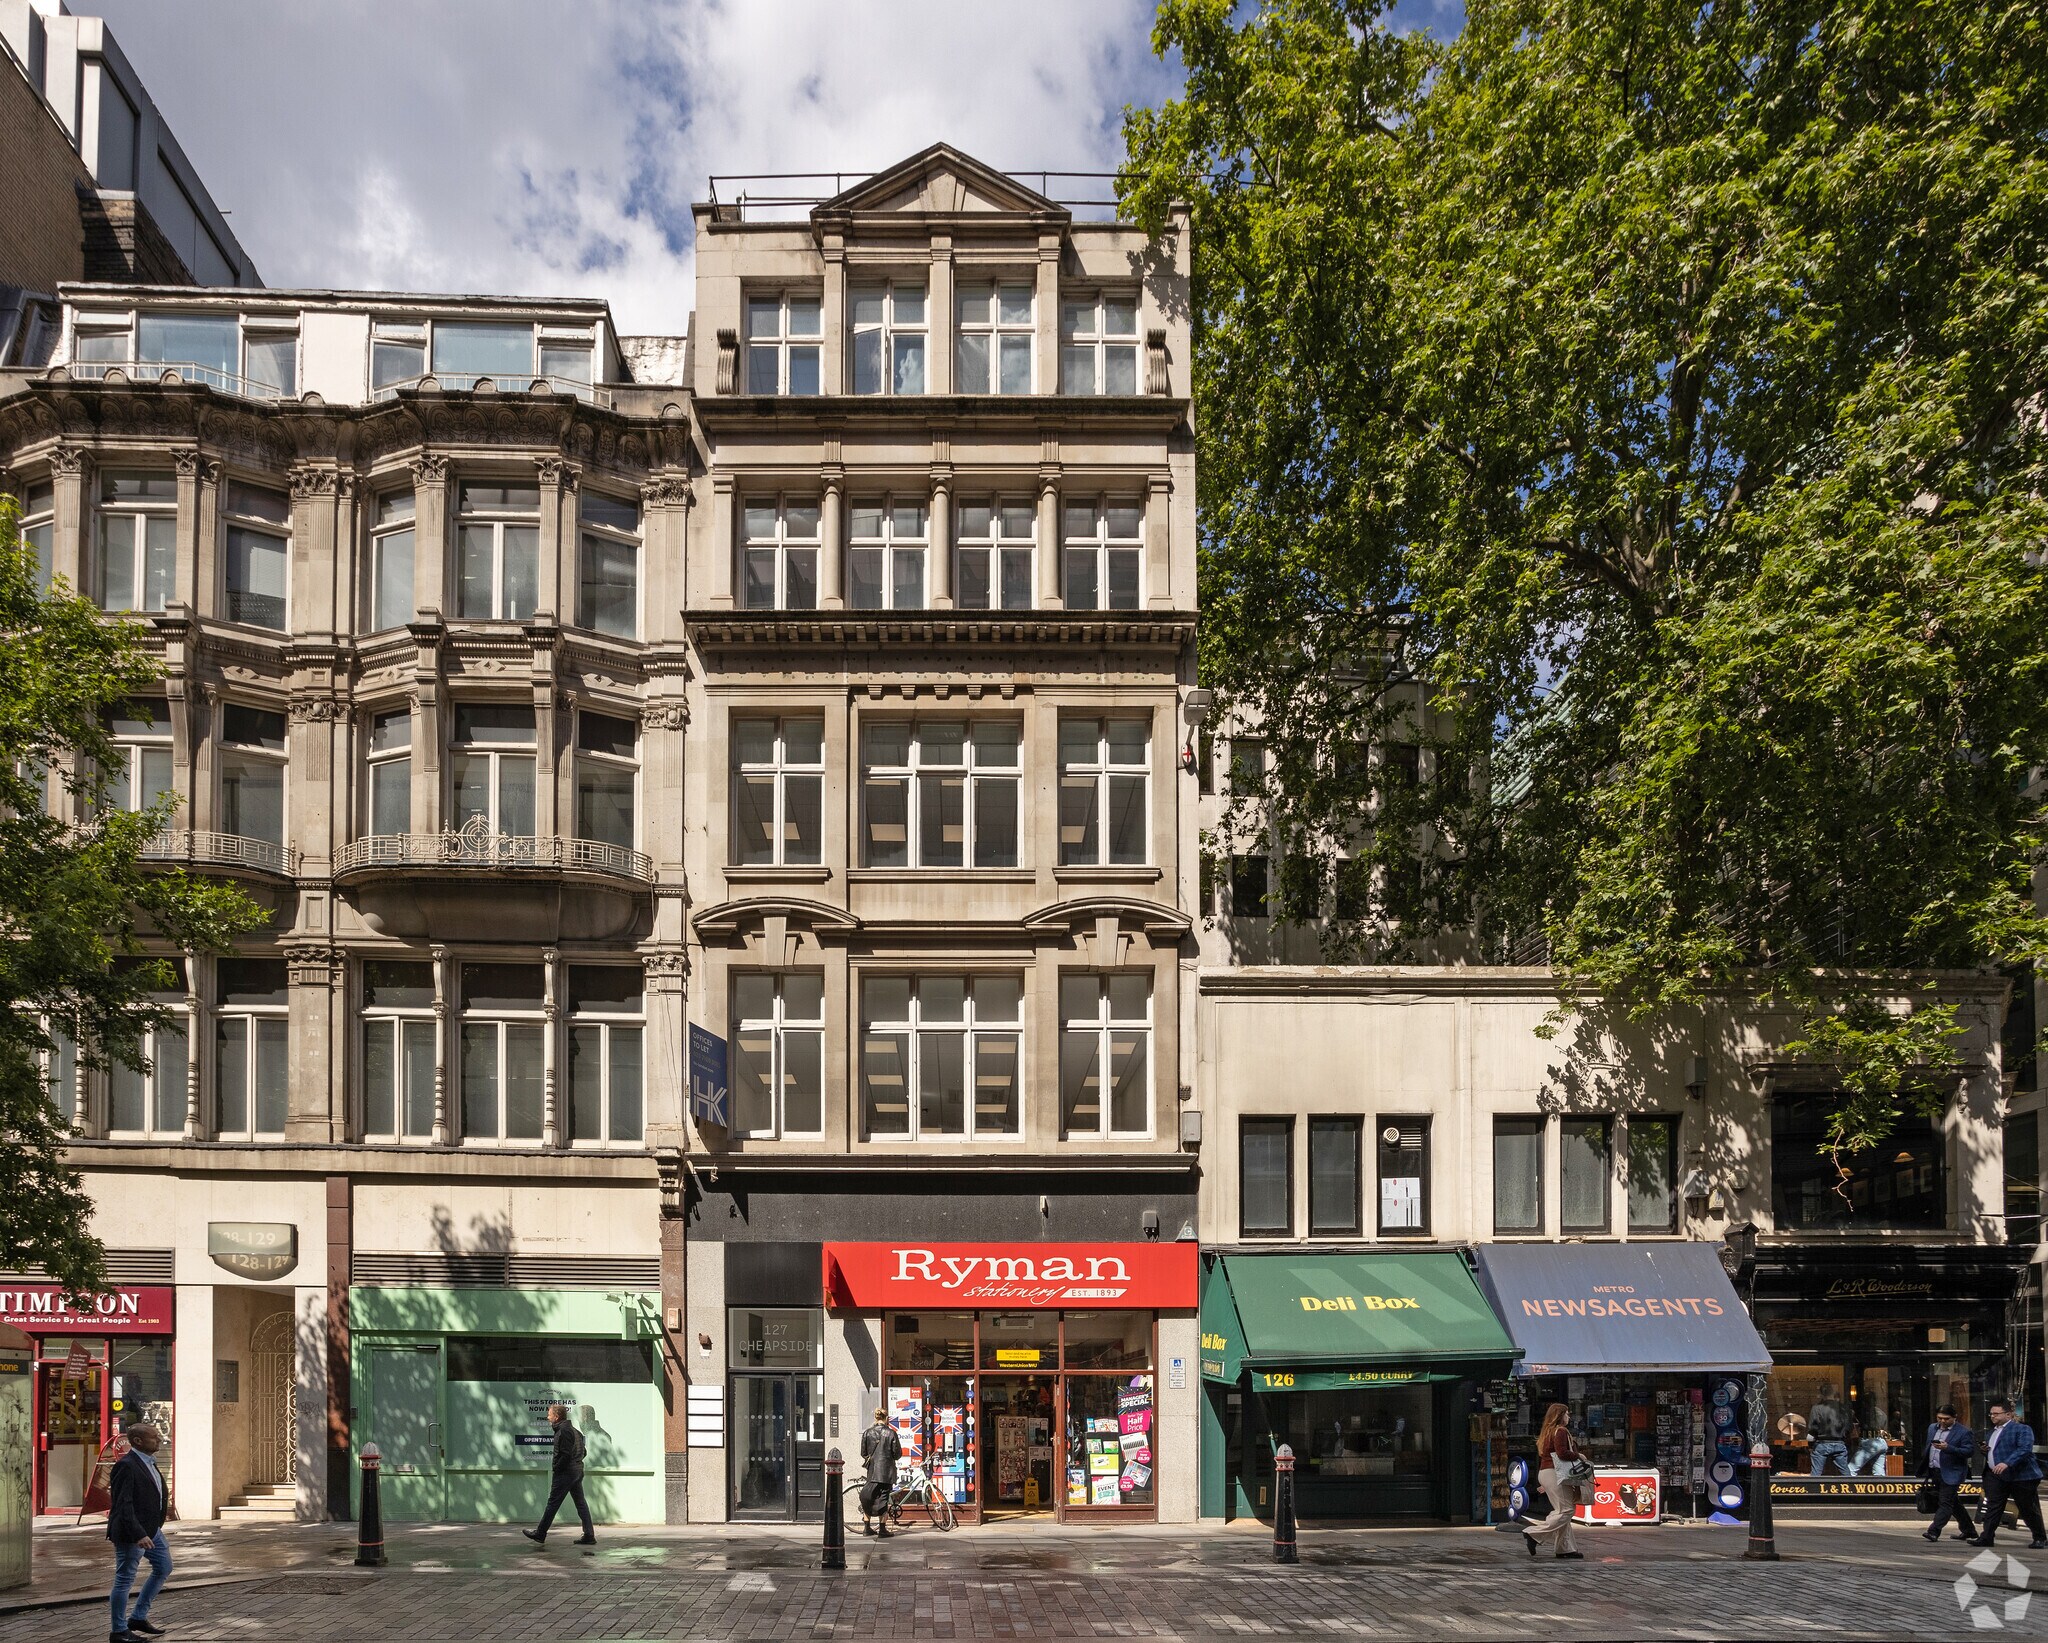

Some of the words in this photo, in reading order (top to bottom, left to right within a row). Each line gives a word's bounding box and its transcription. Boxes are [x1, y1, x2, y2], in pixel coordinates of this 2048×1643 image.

[692, 1032, 713, 1047] OFFICES
[692, 1040, 700, 1049] TO
[700, 1044, 710, 1054] LET
[890, 1249, 1132, 1289] Ryman
[963, 1281, 1066, 1305] stationery
[1095, 1289, 1118, 1297] 1893
[1592, 1285, 1635, 1293] METRO
[1300, 1296, 1357, 1311] Deli
[1363, 1295, 1421, 1310] Box
[1521, 1298, 1724, 1317] NEWSAGENTS
[63, 1316, 75, 1325] By
[103, 1317, 131, 1325] People
[764, 1324, 788, 1335] 127
[739, 1340, 813, 1351] CHEAPSIDE
[1201, 1333, 1212, 1349] Deli
[1211, 1334, 1228, 1350] Box
[1531, 1364, 1550, 1373] 125
[1263, 1373, 1295, 1387] 126
[1348, 1373, 1378, 1381] £4.50
[1381, 1371, 1414, 1380] CURRY
[1120, 1398, 1150, 1409] SPECIAL
[1127, 1415, 1144, 1426] Half
[1127, 1424, 1144, 1432] Price
